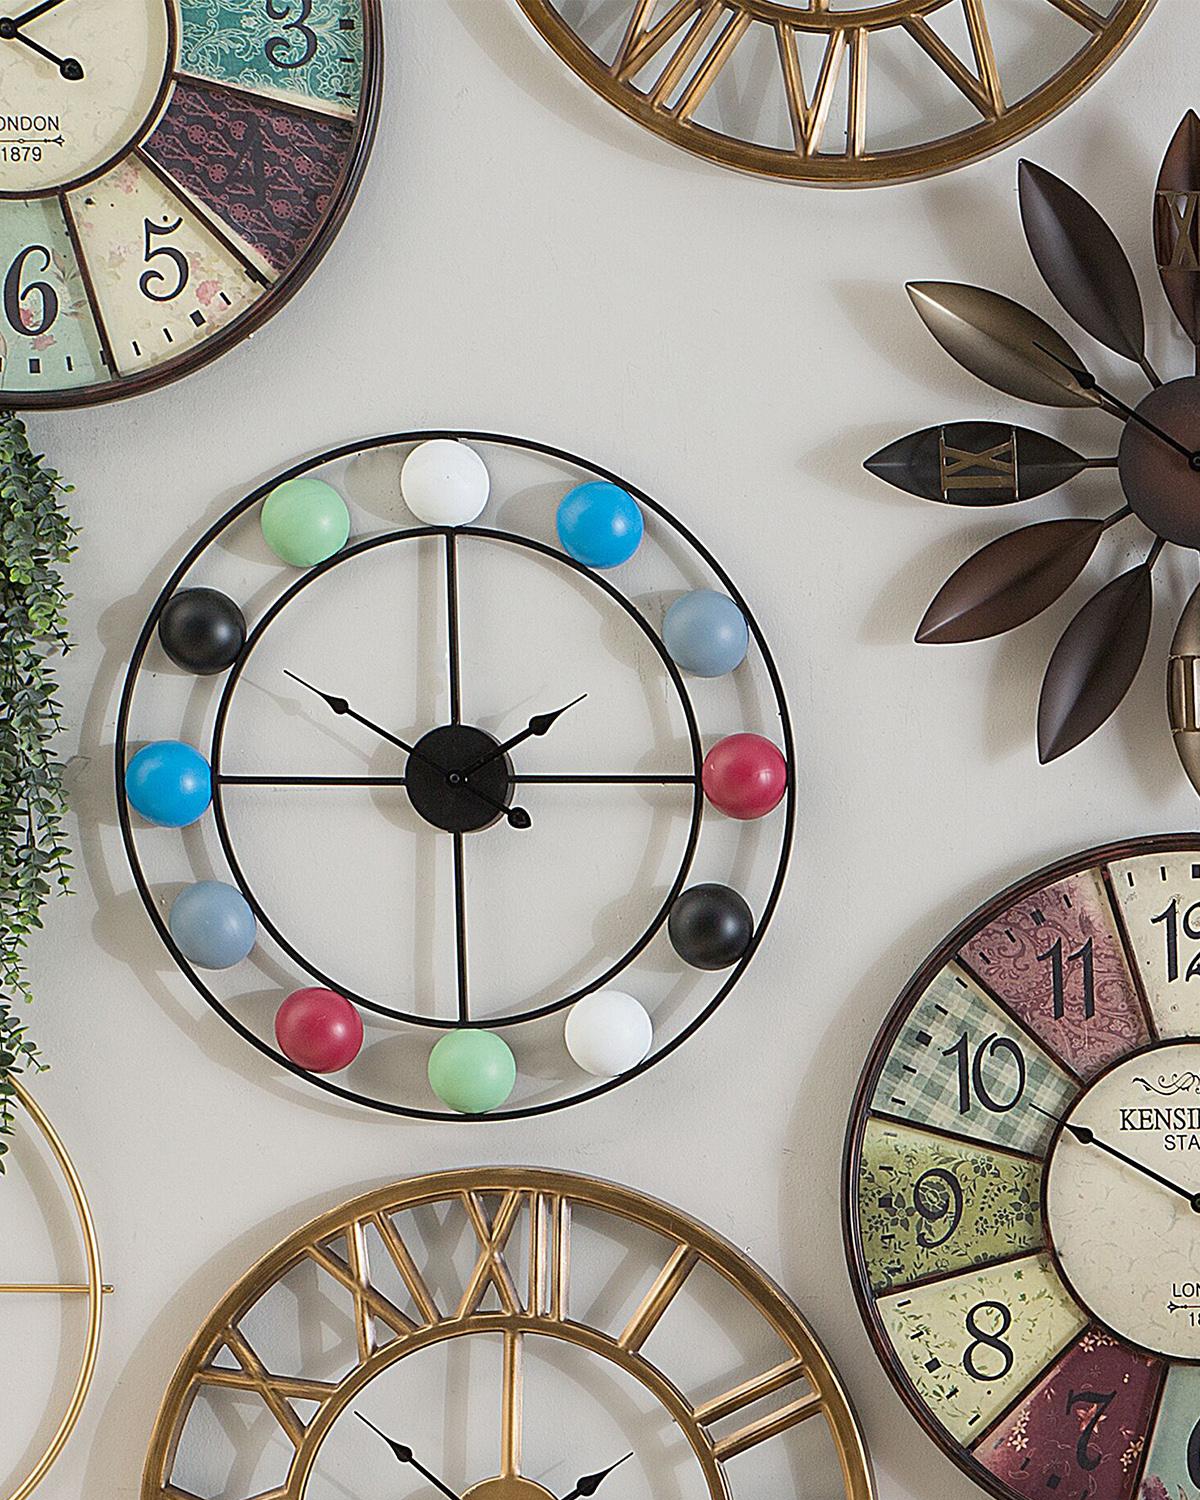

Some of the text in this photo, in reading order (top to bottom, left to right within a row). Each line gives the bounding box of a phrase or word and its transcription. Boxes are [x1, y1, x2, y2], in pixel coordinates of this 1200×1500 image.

[264, 0, 318, 69] 3
[1, 146, 42, 162] 1879
[3, 244, 59, 337] 6
[138, 215, 191, 302] 5
[1036, 936, 1095, 1021] 11
[943, 1031, 1027, 1115] 10
[913, 1167, 964, 1248] 9
[459, 1189, 570, 1321] XII
[962, 1301, 1014, 1381] 8
[1064, 1389, 1118, 1471] 7
